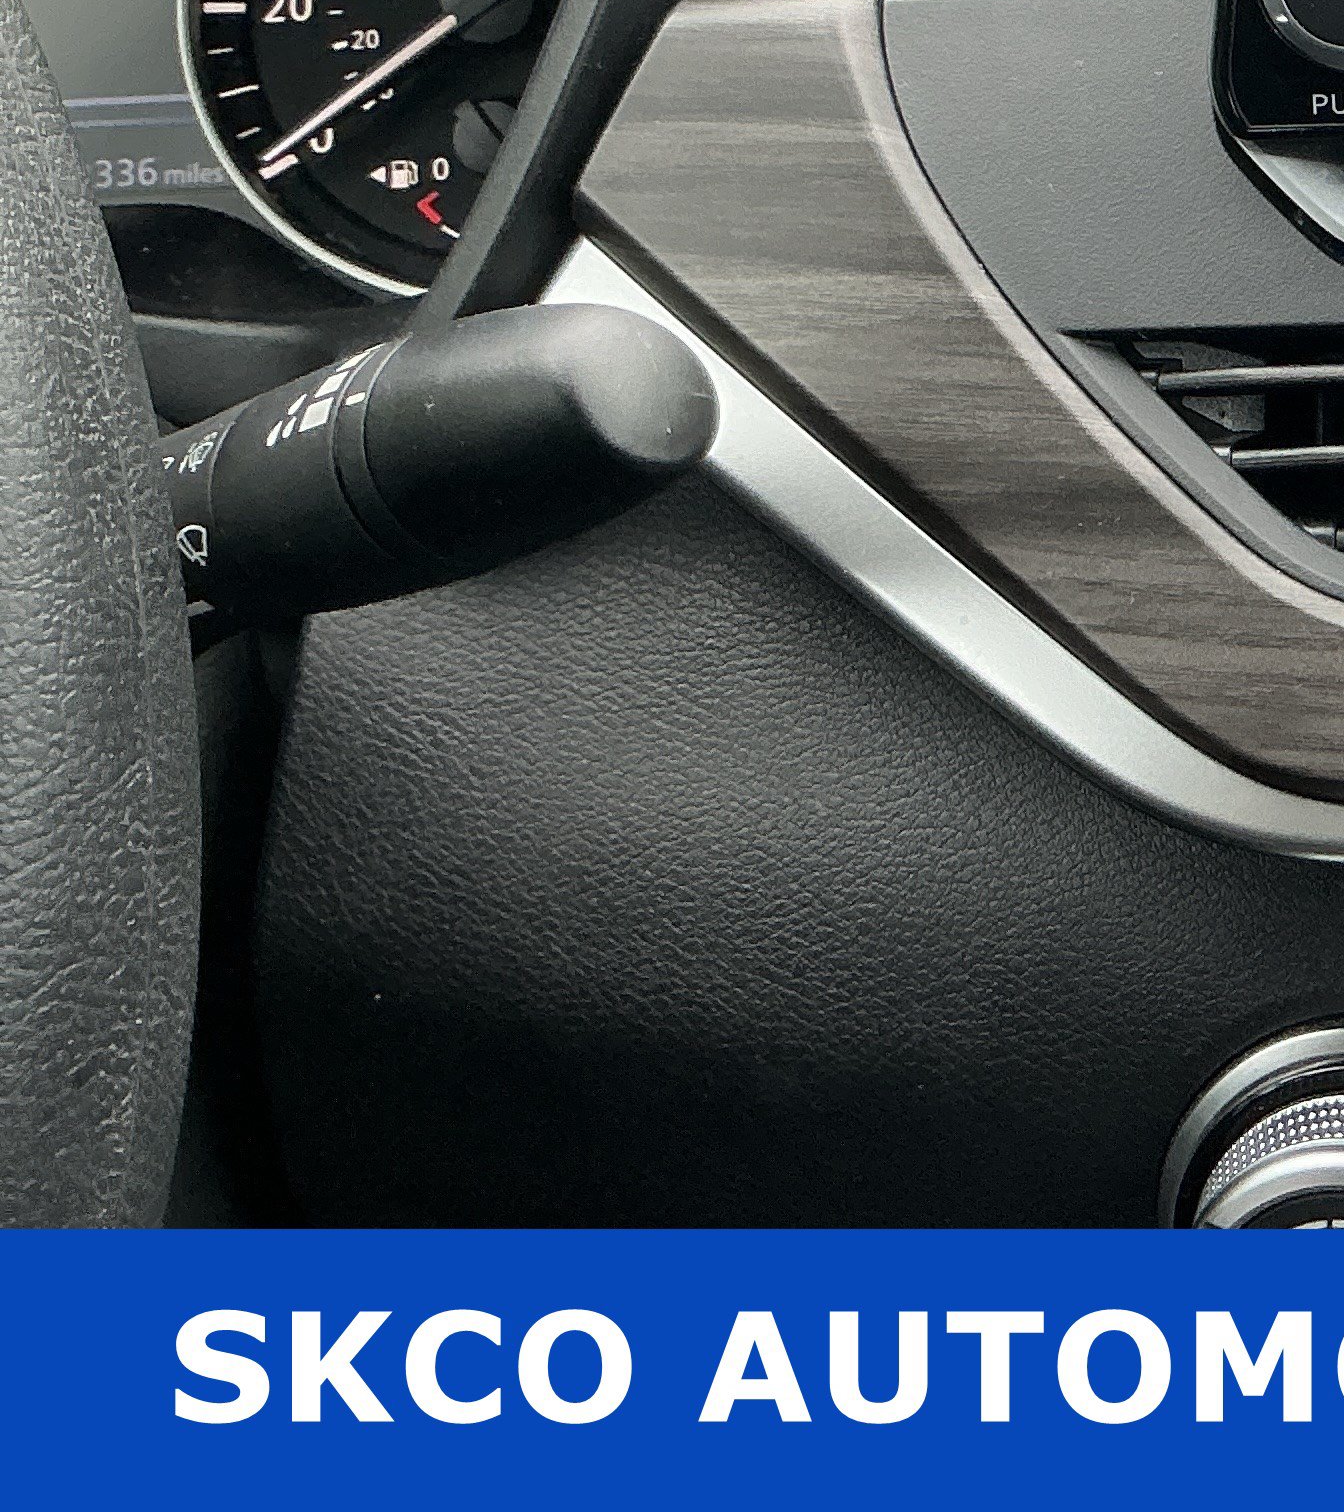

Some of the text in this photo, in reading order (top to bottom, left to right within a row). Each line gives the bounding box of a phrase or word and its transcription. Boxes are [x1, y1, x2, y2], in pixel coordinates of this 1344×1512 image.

[351, 29, 381, 50] 20
[95, 157, 158, 188] 336
[431, 157, 450, 181] 0
